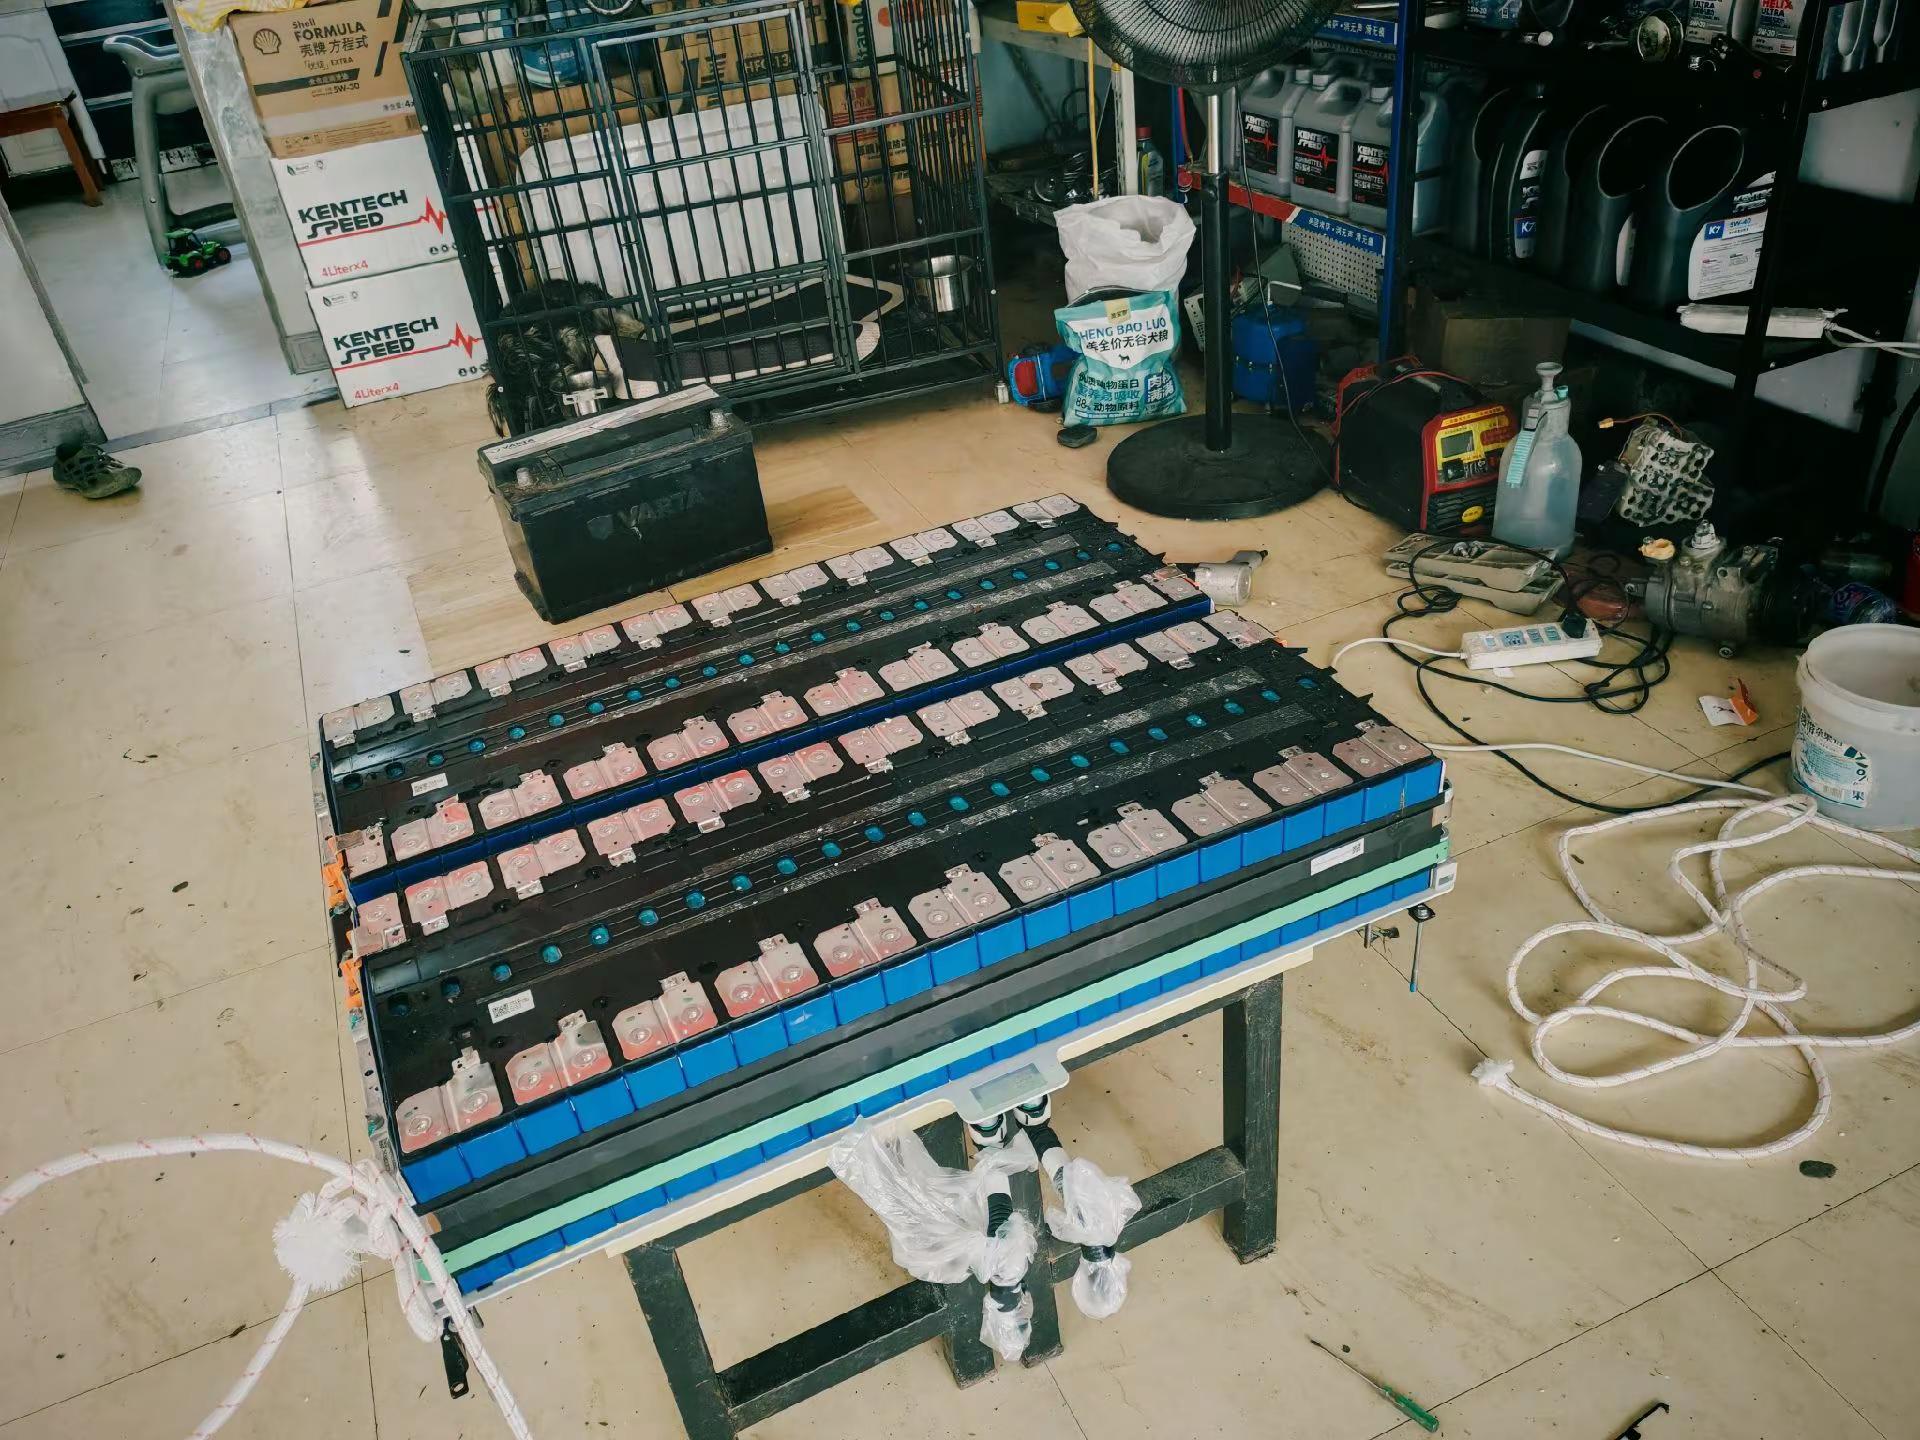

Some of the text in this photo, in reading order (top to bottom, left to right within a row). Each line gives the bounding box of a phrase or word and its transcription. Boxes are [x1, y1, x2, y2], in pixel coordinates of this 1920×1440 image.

[1761, 8, 1785, 17] ULTRA
[292, 17, 316, 29] Shell
[294, 21, 366, 42] FORMULA
[299, 34, 369, 58] 壳牌 方程式
[330, 56, 354, 66] EXTRA
[298, 189, 408, 224] KENTECH
[307, 212, 384, 240] SPEED
[1708, 225, 1721, 235] K7
[321, 260, 369, 278] 4Literx4
[333, 316, 439, 352] KENTECH
[1117, 322, 1143, 335] BAO
[1146, 317, 1167, 331] LUO
[340, 337, 415, 366] SPEED
[354, 382, 400, 400] 4Literx4
